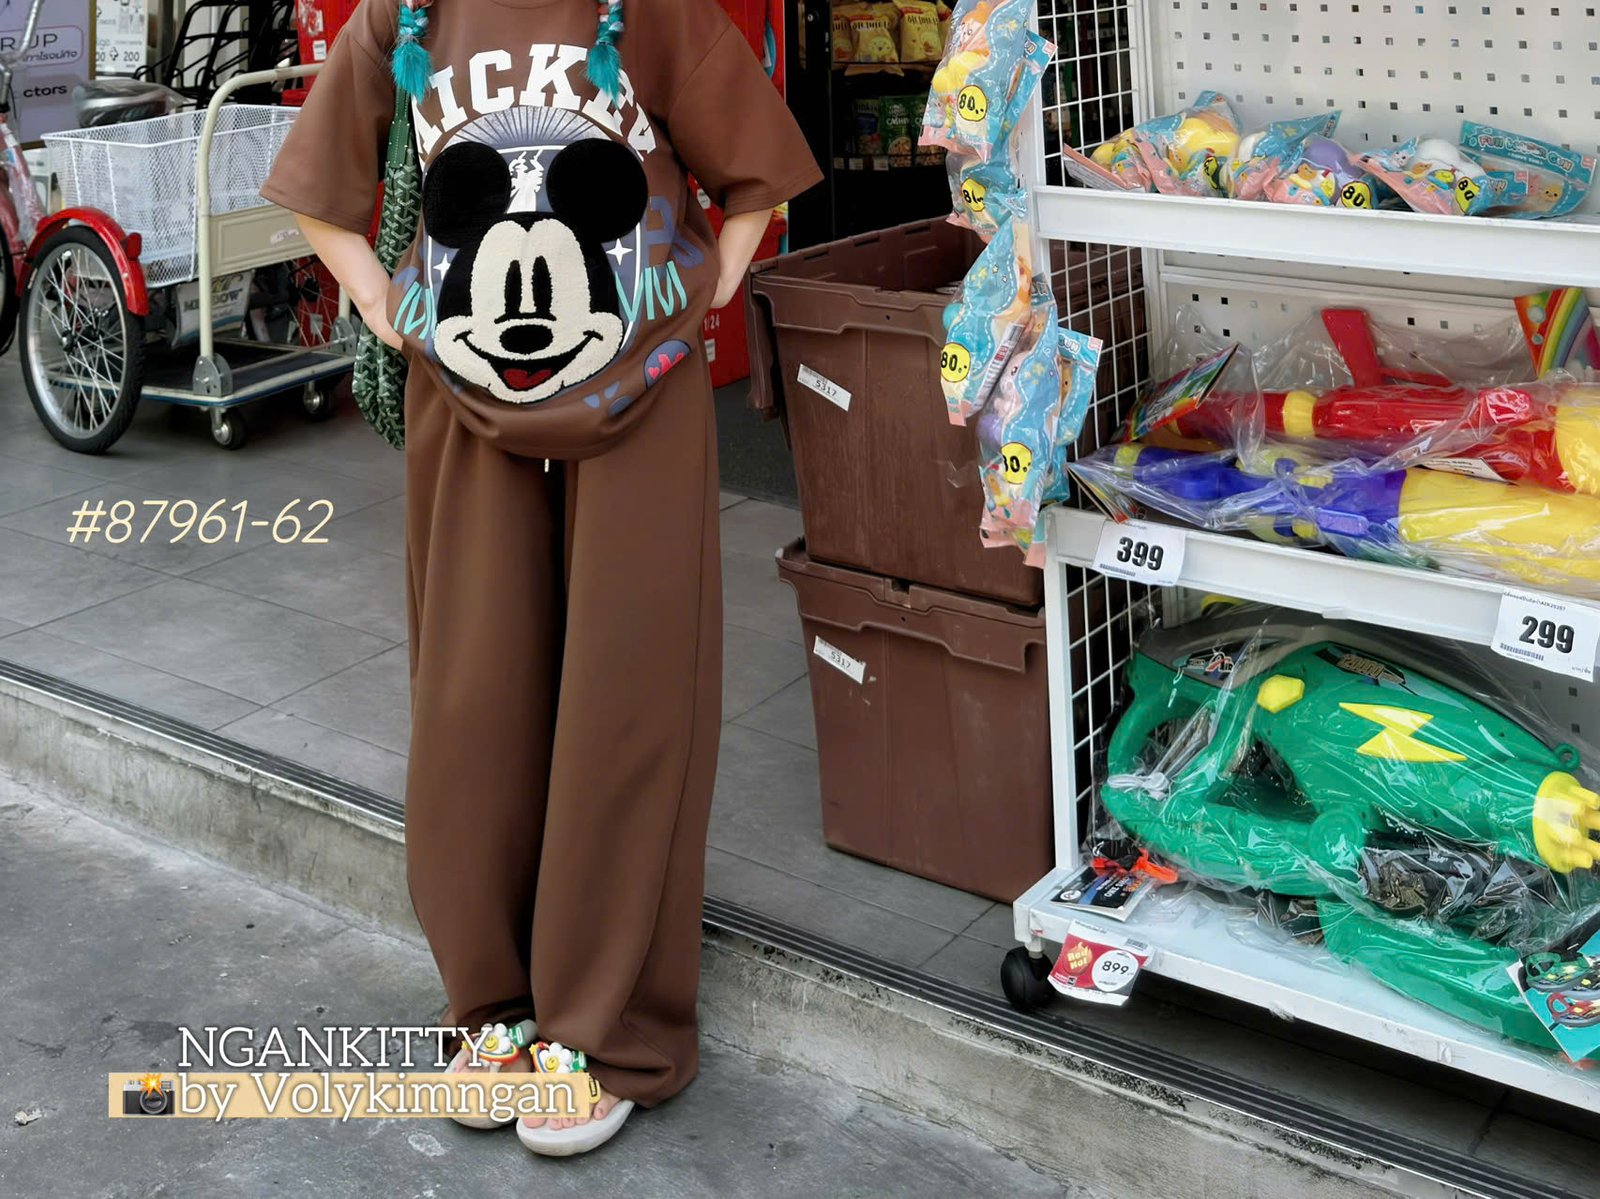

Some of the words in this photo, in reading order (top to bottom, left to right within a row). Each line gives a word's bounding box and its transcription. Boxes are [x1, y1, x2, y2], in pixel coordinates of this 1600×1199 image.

[0, 33, 58, 52] RUP
[123, 51, 140, 62] 200
[815, 379, 838, 397] 5317
[1116, 536, 1164, 571] 399
[1518, 615, 1575, 654] 299
[831, 650, 852, 668] 5317
[1067, 946, 1088, 962] Red
[1069, 957, 1088, 970] Hot
[1101, 960, 1129, 975] 899
